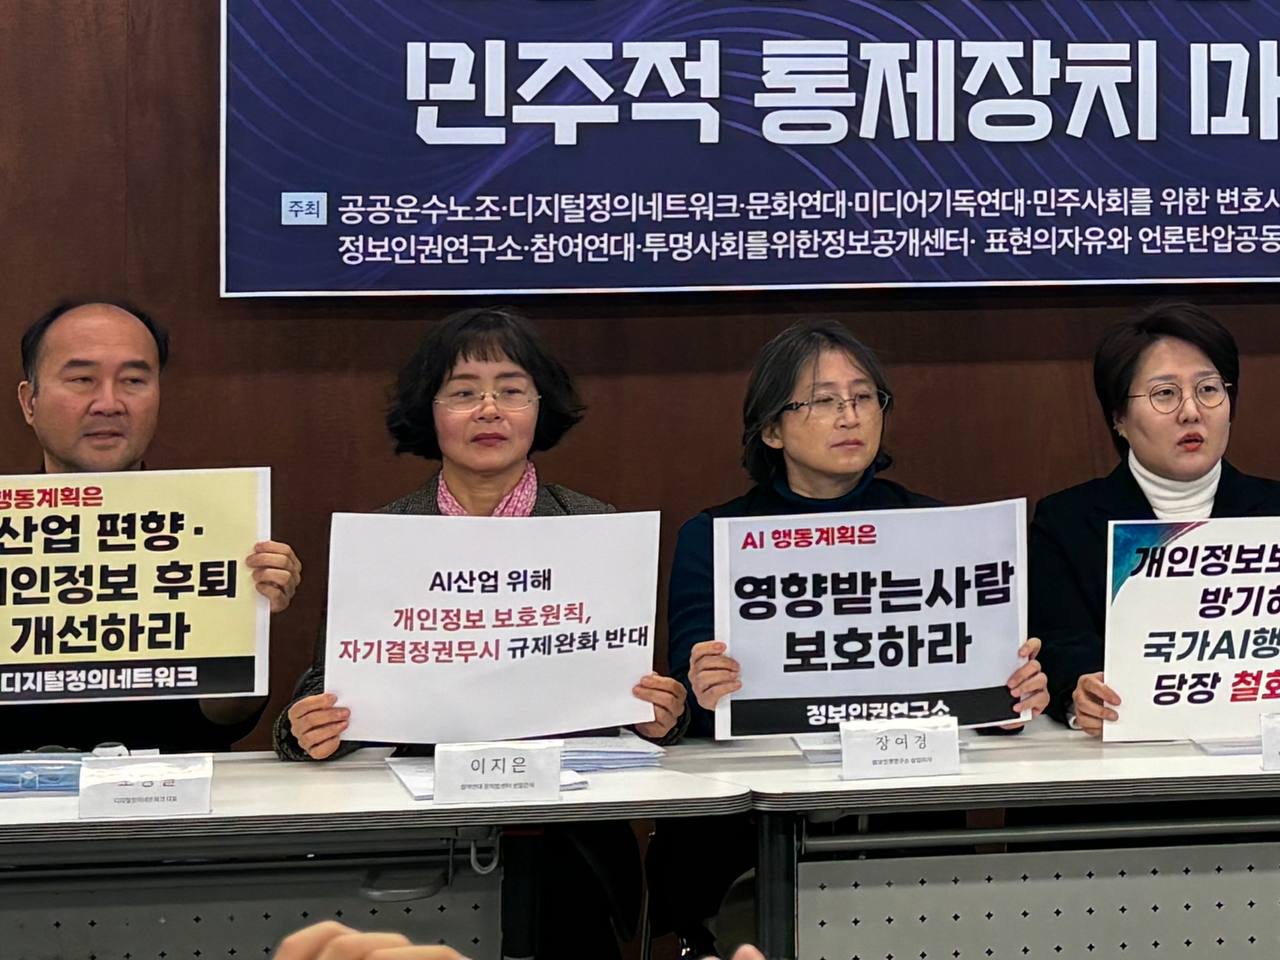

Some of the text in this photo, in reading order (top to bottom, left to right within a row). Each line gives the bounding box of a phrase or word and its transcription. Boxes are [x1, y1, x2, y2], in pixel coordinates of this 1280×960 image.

[407, 40, 719, 145] 민주적
[754, 40, 1156, 144] 통제장치
[289, 201, 319, 218] 주최
[1160, 187, 1210, 215] 위한
[984, 226, 1132, 255] 표현의자유와
[742, 525, 876, 549] AI 행동계획은
[0, 560, 237, 606] 인정보 후퇴
[429, 569, 551, 593] AI산업 위해
[735, 561, 1014, 620] 영향받는사람
[394, 602, 591, 631] 개인정보 보호원칙,
[11, 612, 191, 655] 개선하라
[339, 626, 648, 663] 자기결정권무시 규제완화 반대
[784, 622, 972, 672] 보호하라
[1, 667, 199, 693] 디지털정의네트워크
[1153, 672, 1221, 705] 당장
